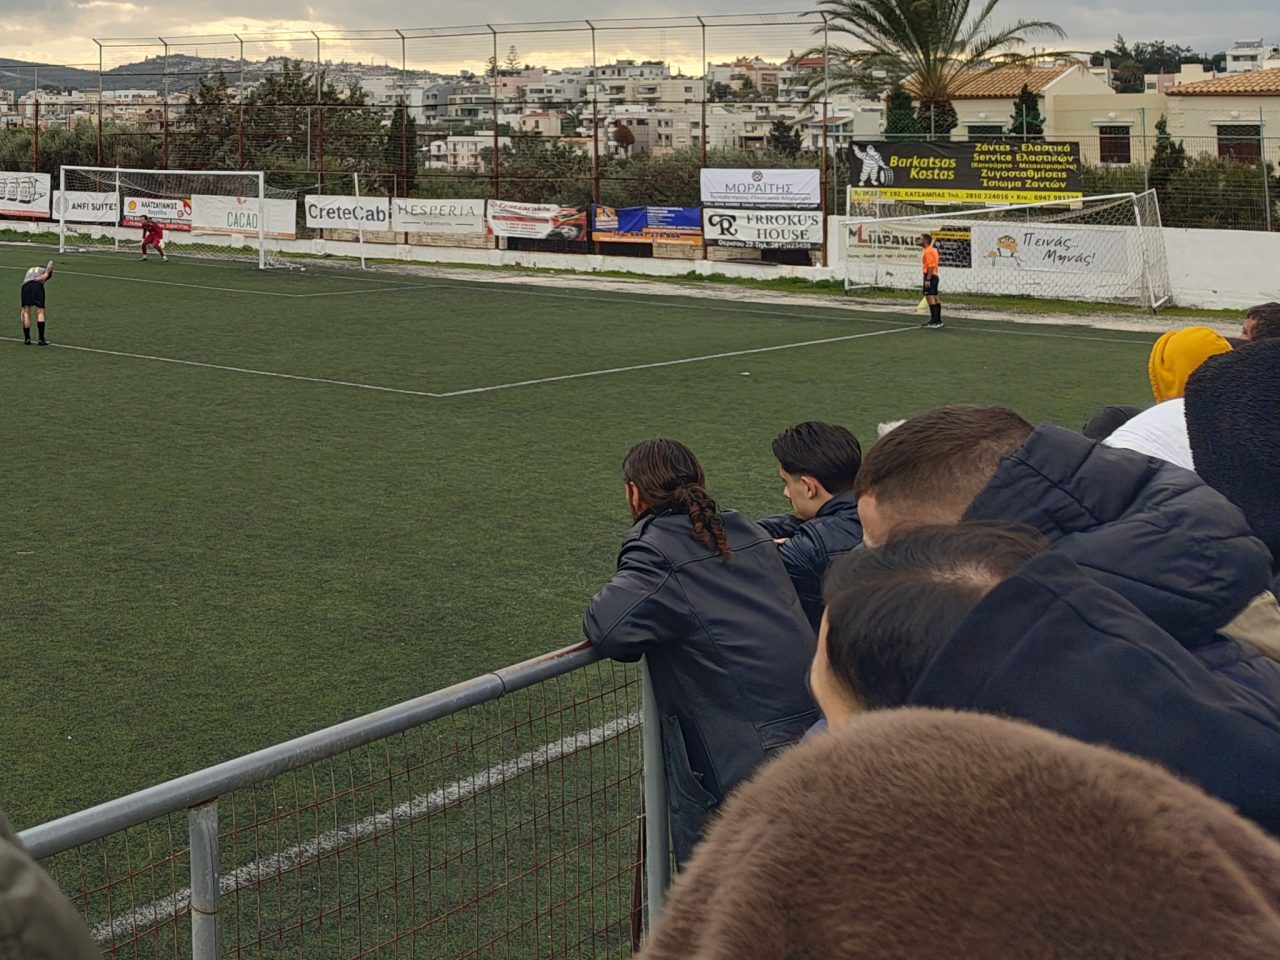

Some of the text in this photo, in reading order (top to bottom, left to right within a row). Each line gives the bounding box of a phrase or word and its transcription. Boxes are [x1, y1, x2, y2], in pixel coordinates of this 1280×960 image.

[1021, 143, 1071, 152] Ελαστικά
[889, 155, 957, 168] Barkatsas
[973, 153, 1074, 162] Service Ελαστικών
[910, 167, 955, 180] Kostas
[725, 182, 793, 193] ΜΩΡΑΪΤΗΣ
[71, 202, 89, 211] ANFI
[308, 203, 387, 222] CreteCab
[397, 203, 476, 217] HESPERIA
[227, 211, 258, 229] CACAO
[746, 214, 819, 226] FRROKU'S
[757, 228, 810, 241] HOUSE
[1042, 249, 1096, 267] Μηνάς!
